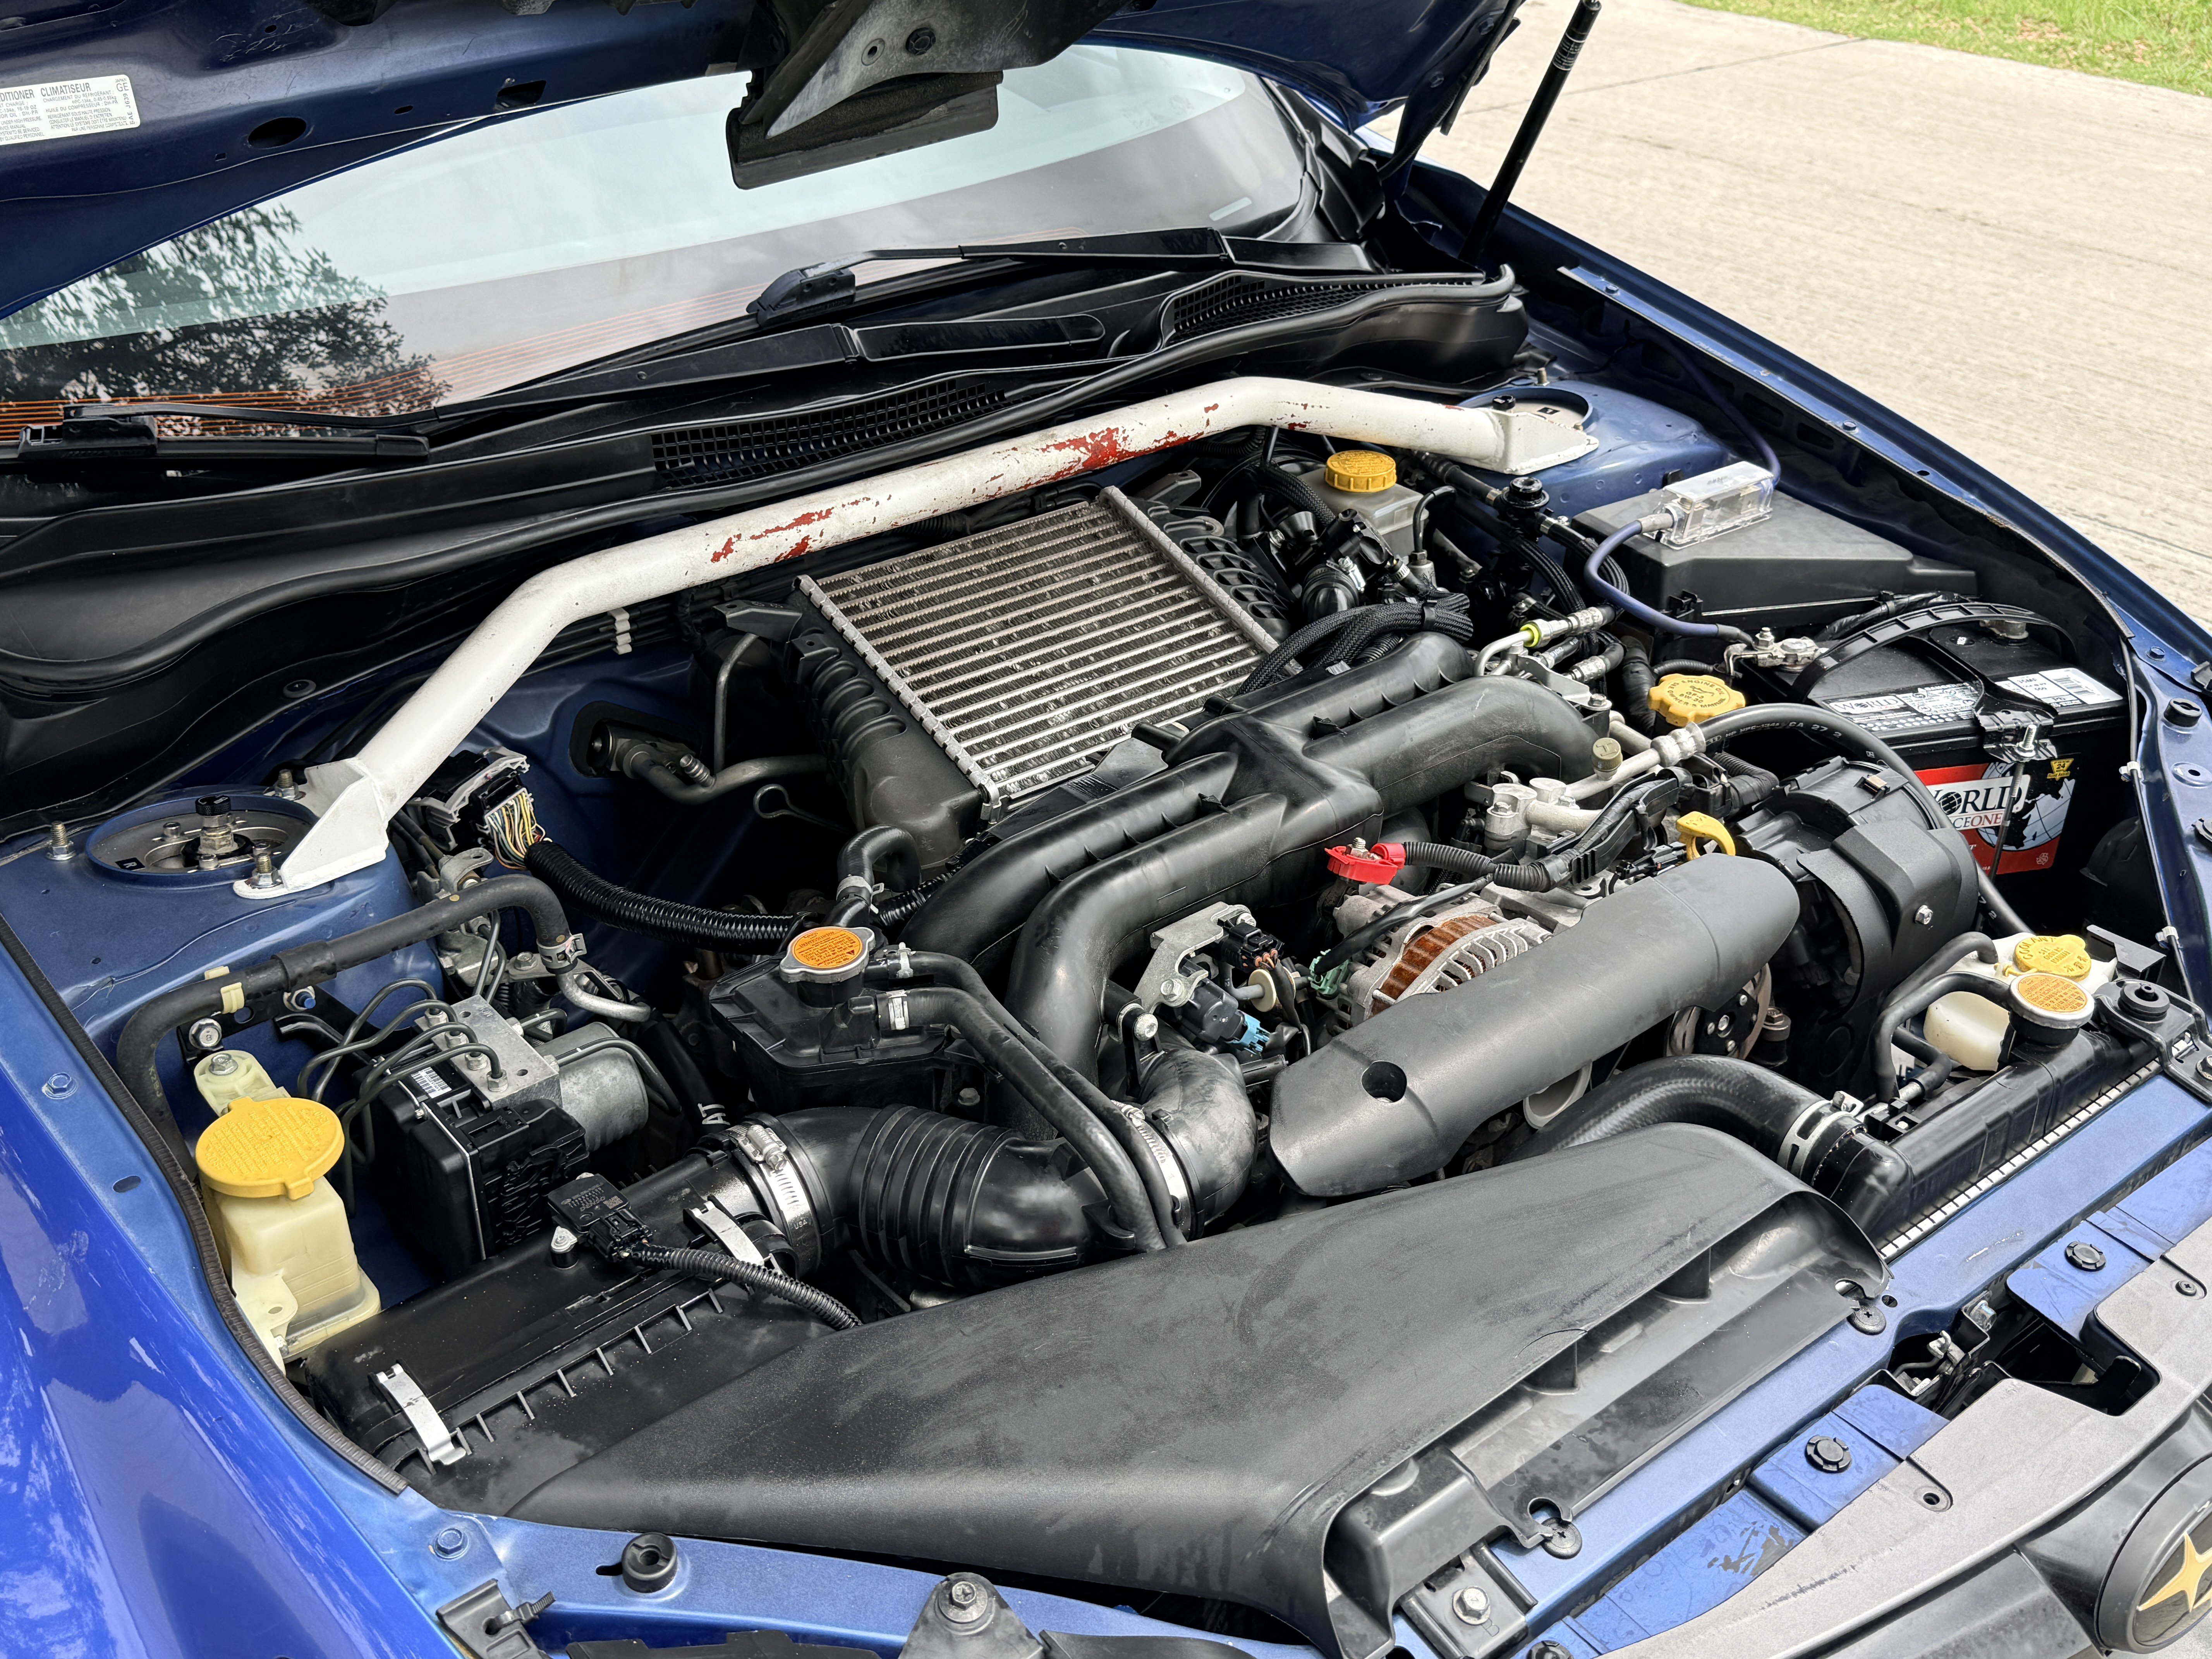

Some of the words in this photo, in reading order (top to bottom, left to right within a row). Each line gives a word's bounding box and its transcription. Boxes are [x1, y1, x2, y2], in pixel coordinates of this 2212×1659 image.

[0, 89, 34, 101] DITIONER
[41, 82, 91, 97] CLIMATISEUR
[117, 82, 129, 91] GE
[1834, 697, 1898, 710] WORLD
[1811, 723, 1828, 732] 27
[1935, 786, 2022, 814] ORLD
[1953, 813, 2004, 828] CEONE
[2019, 937, 2056, 960] COOLANT
[1224, 978, 1230, 987] 12
[697, 1103, 730, 1125] AT
[752, 1125, 773, 1144] NORTON
[580, 1196, 606, 1212] DENSO
[794, 1219, 807, 1230] USA
